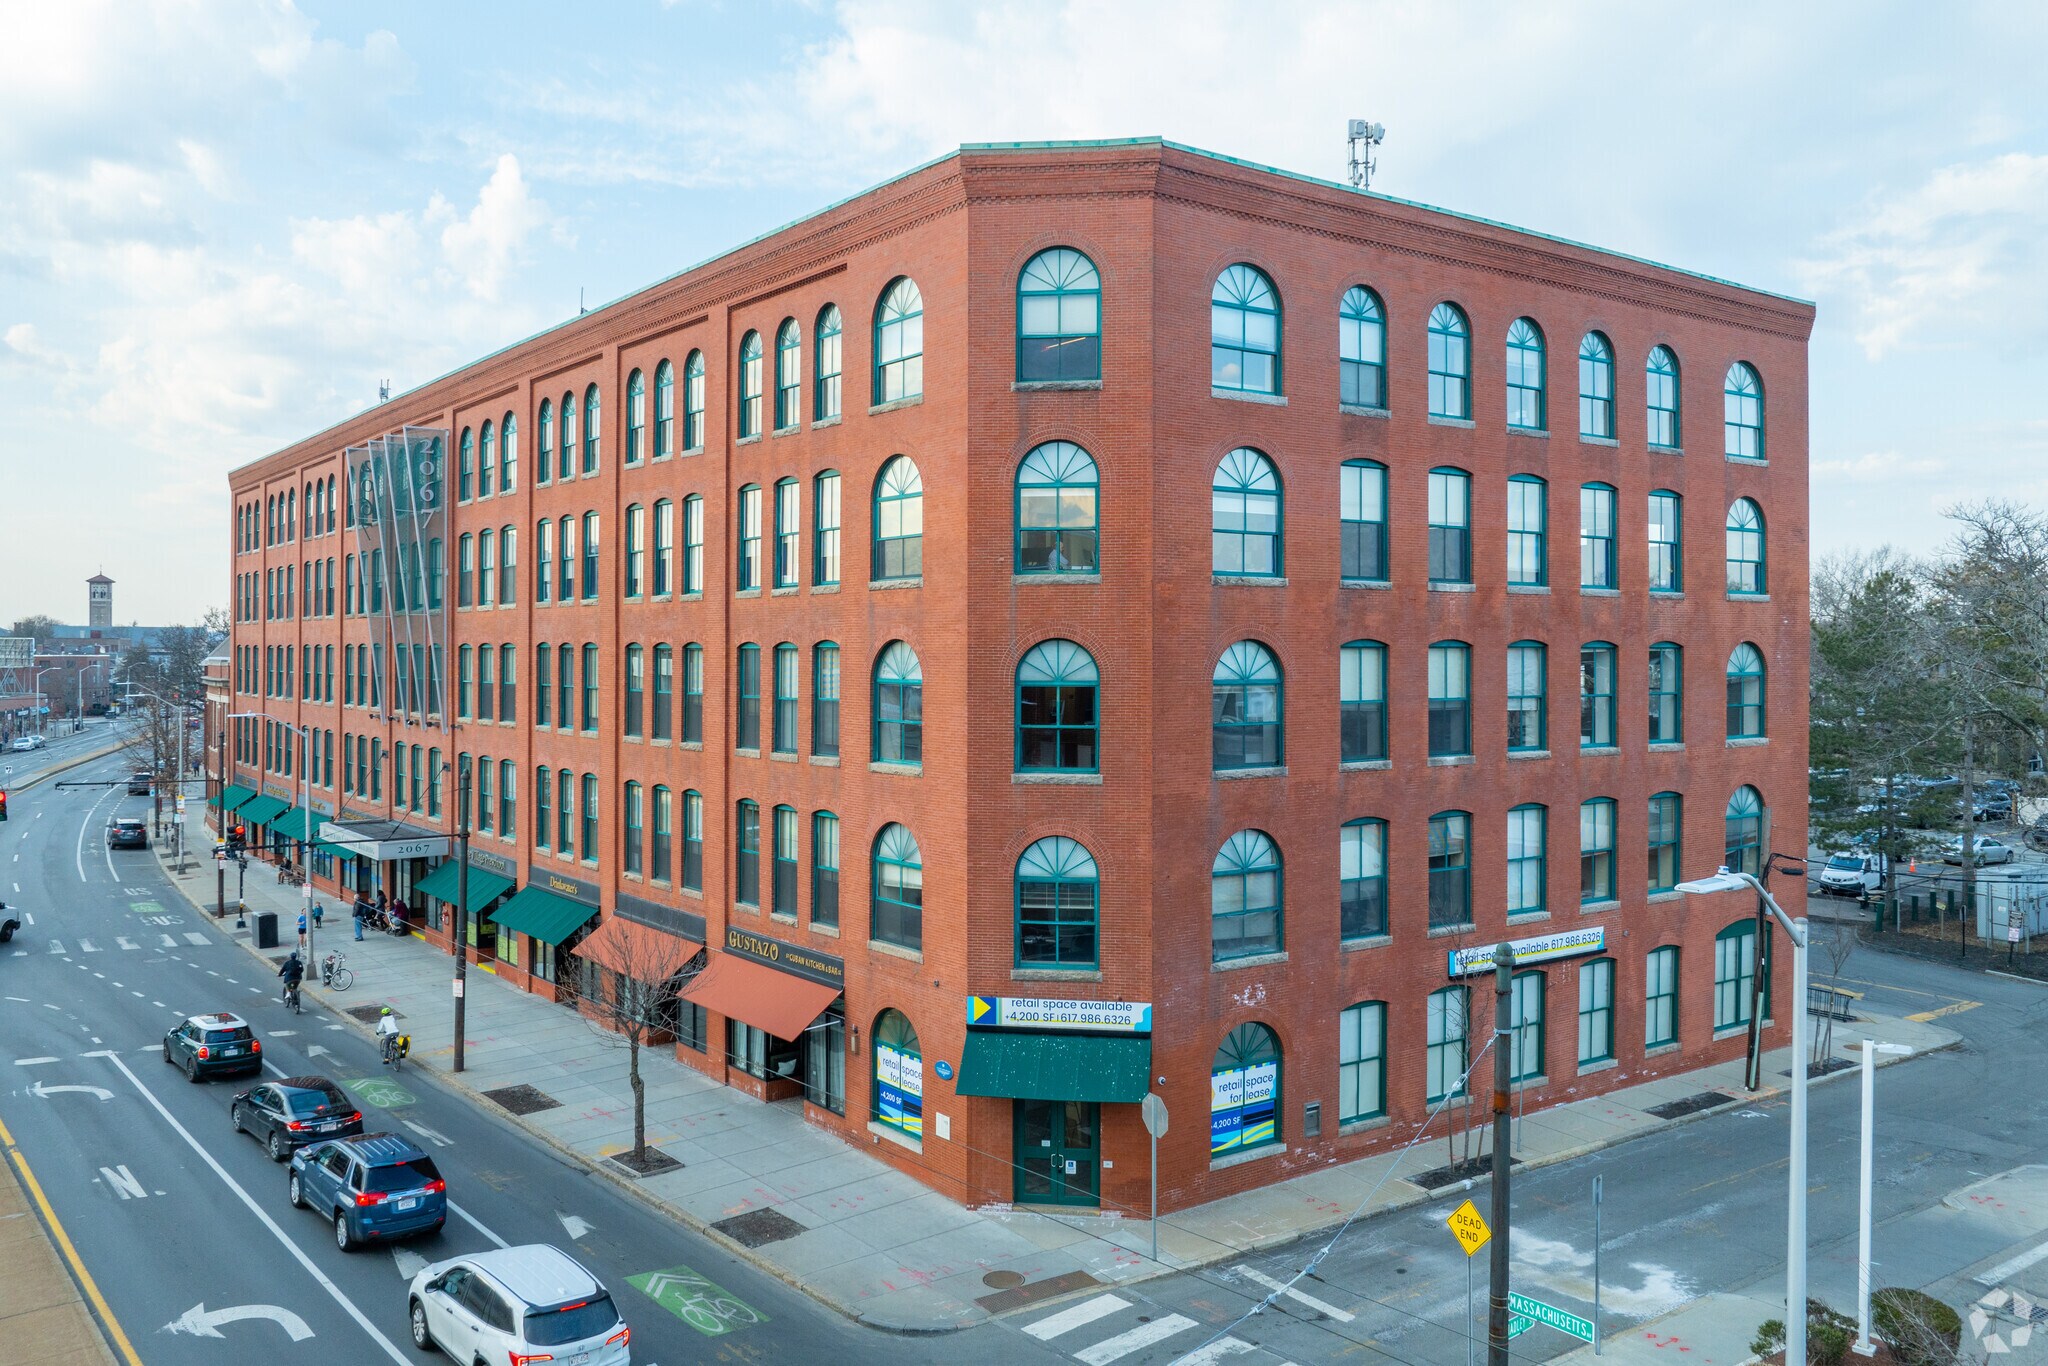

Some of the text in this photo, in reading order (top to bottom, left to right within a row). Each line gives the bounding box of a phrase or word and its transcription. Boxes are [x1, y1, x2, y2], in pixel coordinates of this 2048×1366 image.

[420, 439, 435, 529] 2067
[398, 843, 430, 854] 2067
[729, 930, 778, 961] GUSTAZO
[1551, 931, 1601, 949] 617.986.6326
[789, 953, 805, 965] CUBAN
[805, 959, 825, 972] KITCHEN
[828, 965, 838, 975] BAR
[1011, 998, 1132, 1012] retail space available
[1060, 1013, 1131, 1025] 617.986.6326
[882, 1058, 899, 1070] retail
[902, 1066, 922, 1079] space
[890, 1072, 920, 1091] for lease
[1219, 1074, 1274, 1092] retail space
[1230, 1088, 1270, 1103] for lease
[1232, 1116, 1241, 1125] SF
[1456, 1213, 1482, 1230] DEAD
[1460, 1228, 1479, 1243] END
[1509, 1295, 1587, 1336] MASSACHUSETTS
[1508, 1316, 1526, 1336] ADLEY
